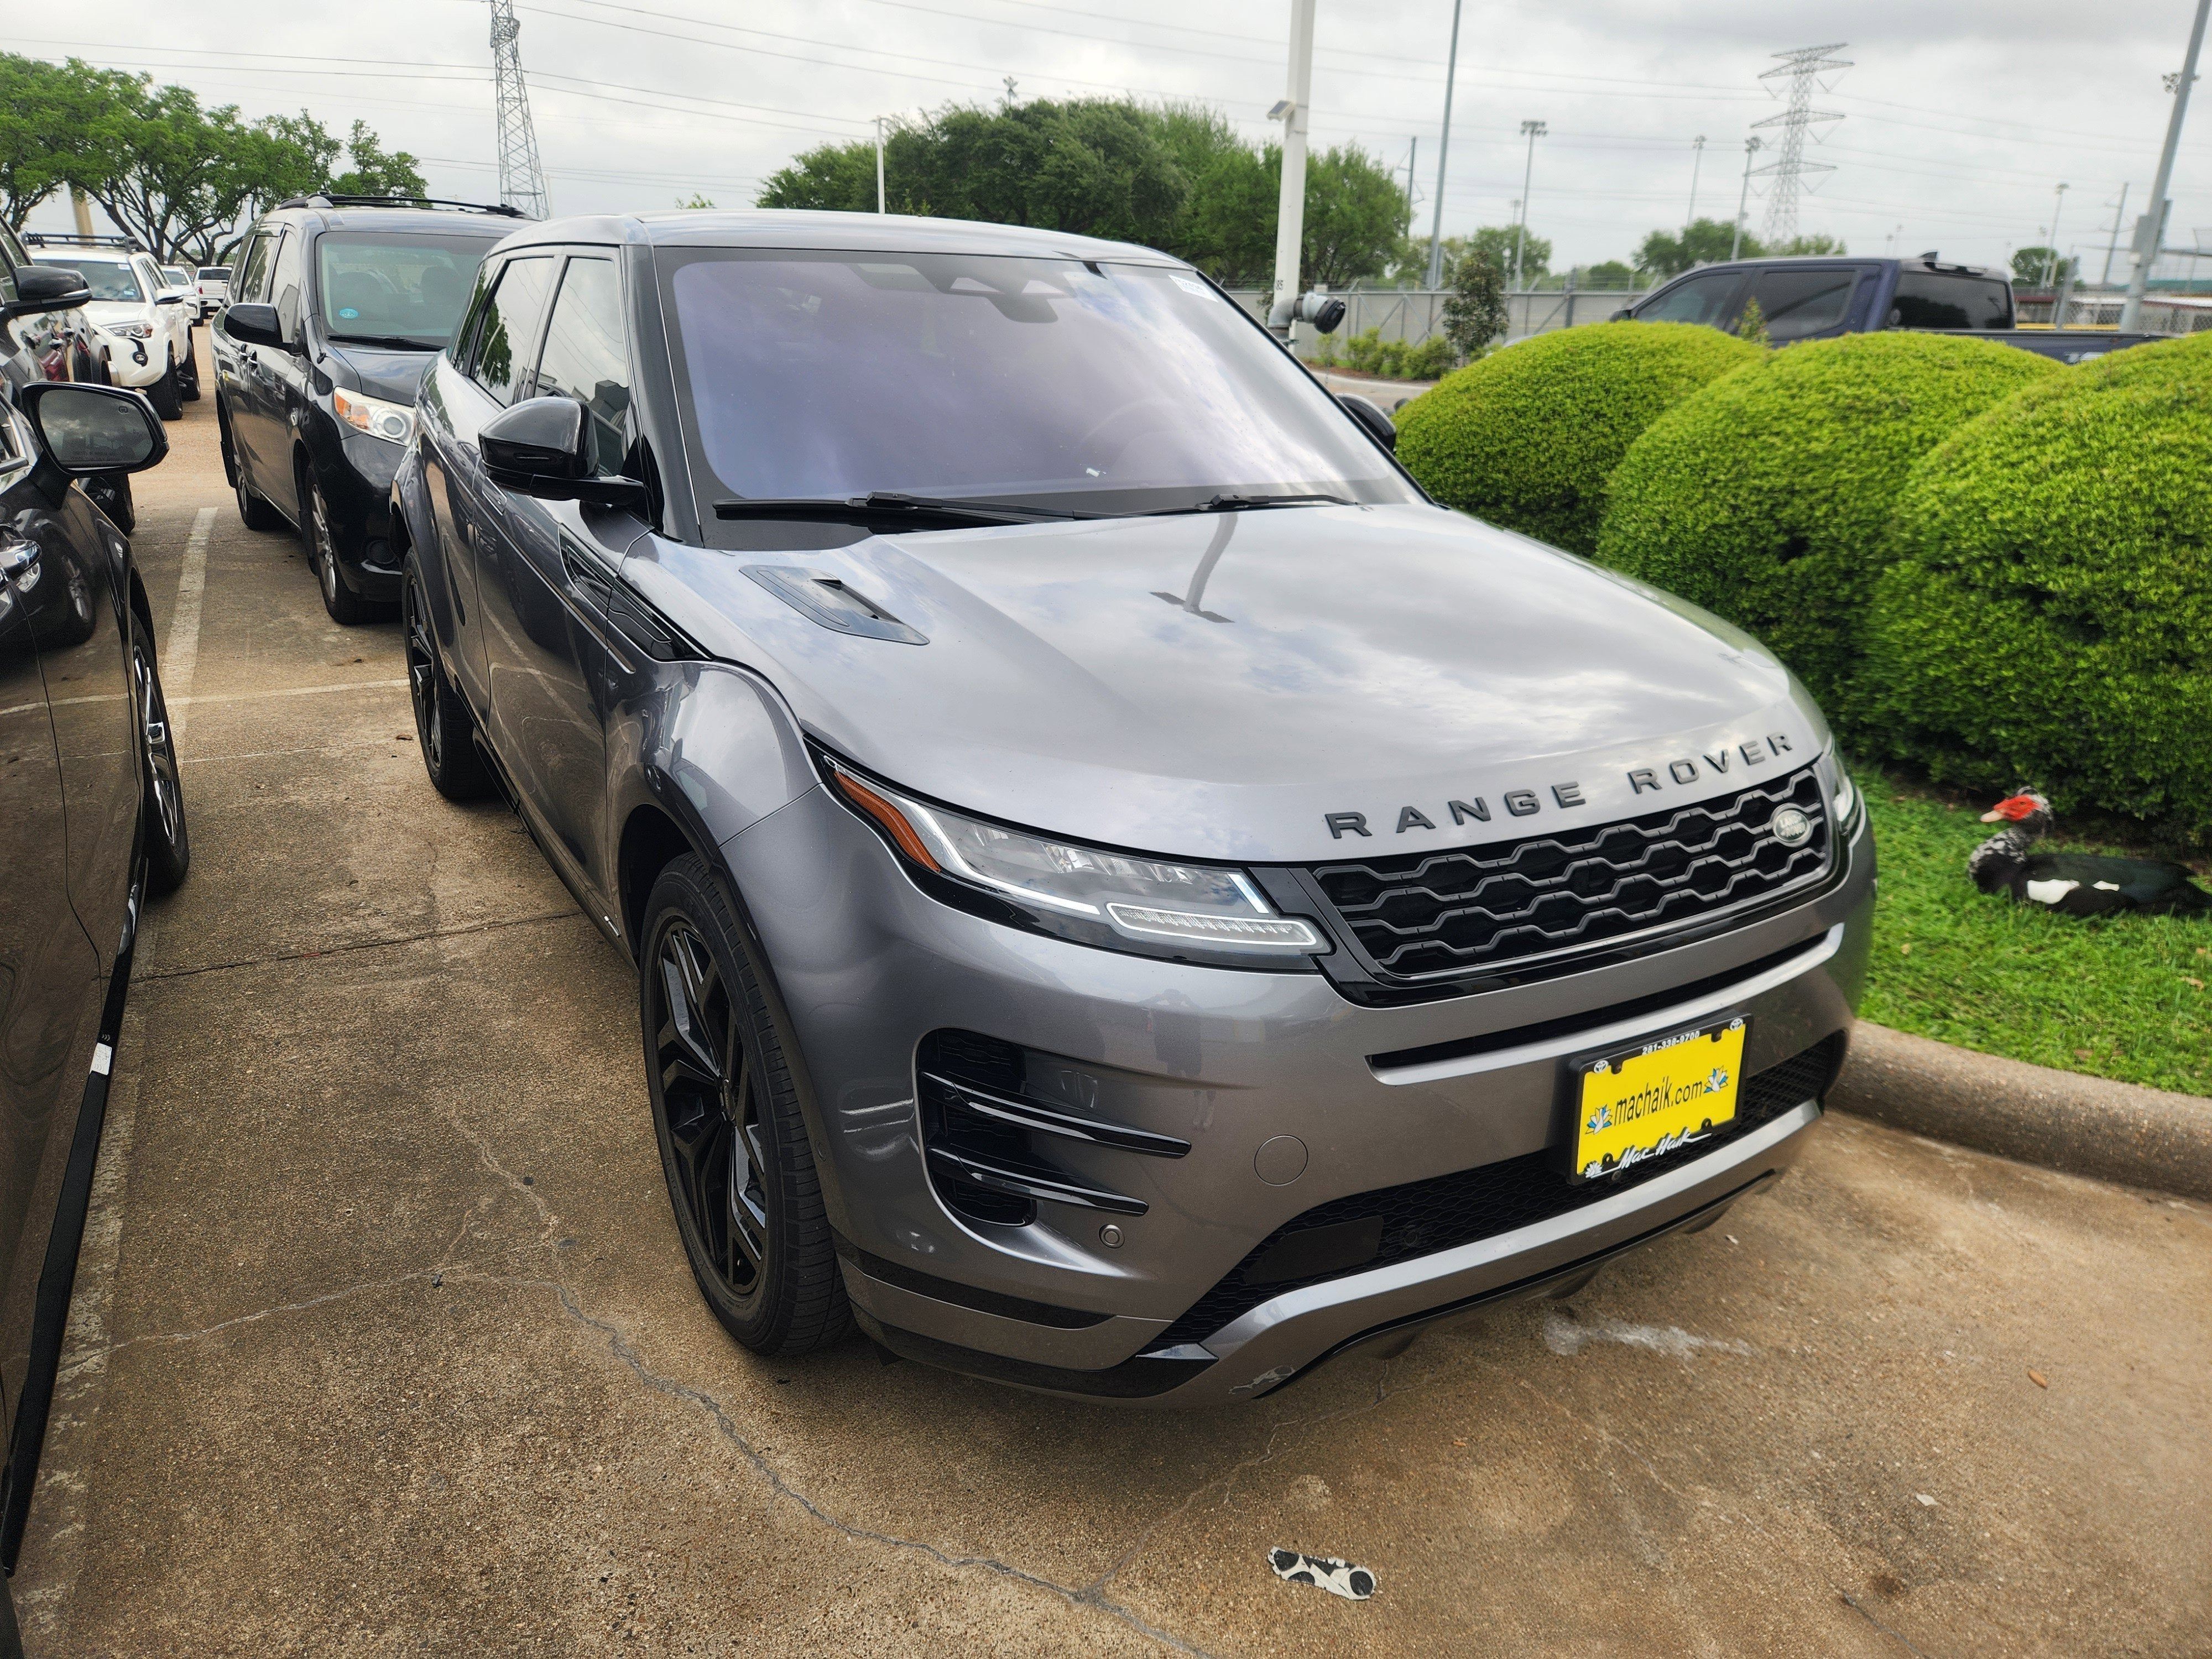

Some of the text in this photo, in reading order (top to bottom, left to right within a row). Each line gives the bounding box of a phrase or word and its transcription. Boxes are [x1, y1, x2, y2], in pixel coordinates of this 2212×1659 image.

[1324, 731, 1793, 839] RANGE ROVER
[1614, 1076, 1703, 1126] machaik.com
[1613, 1145, 1655, 1170] Mac
